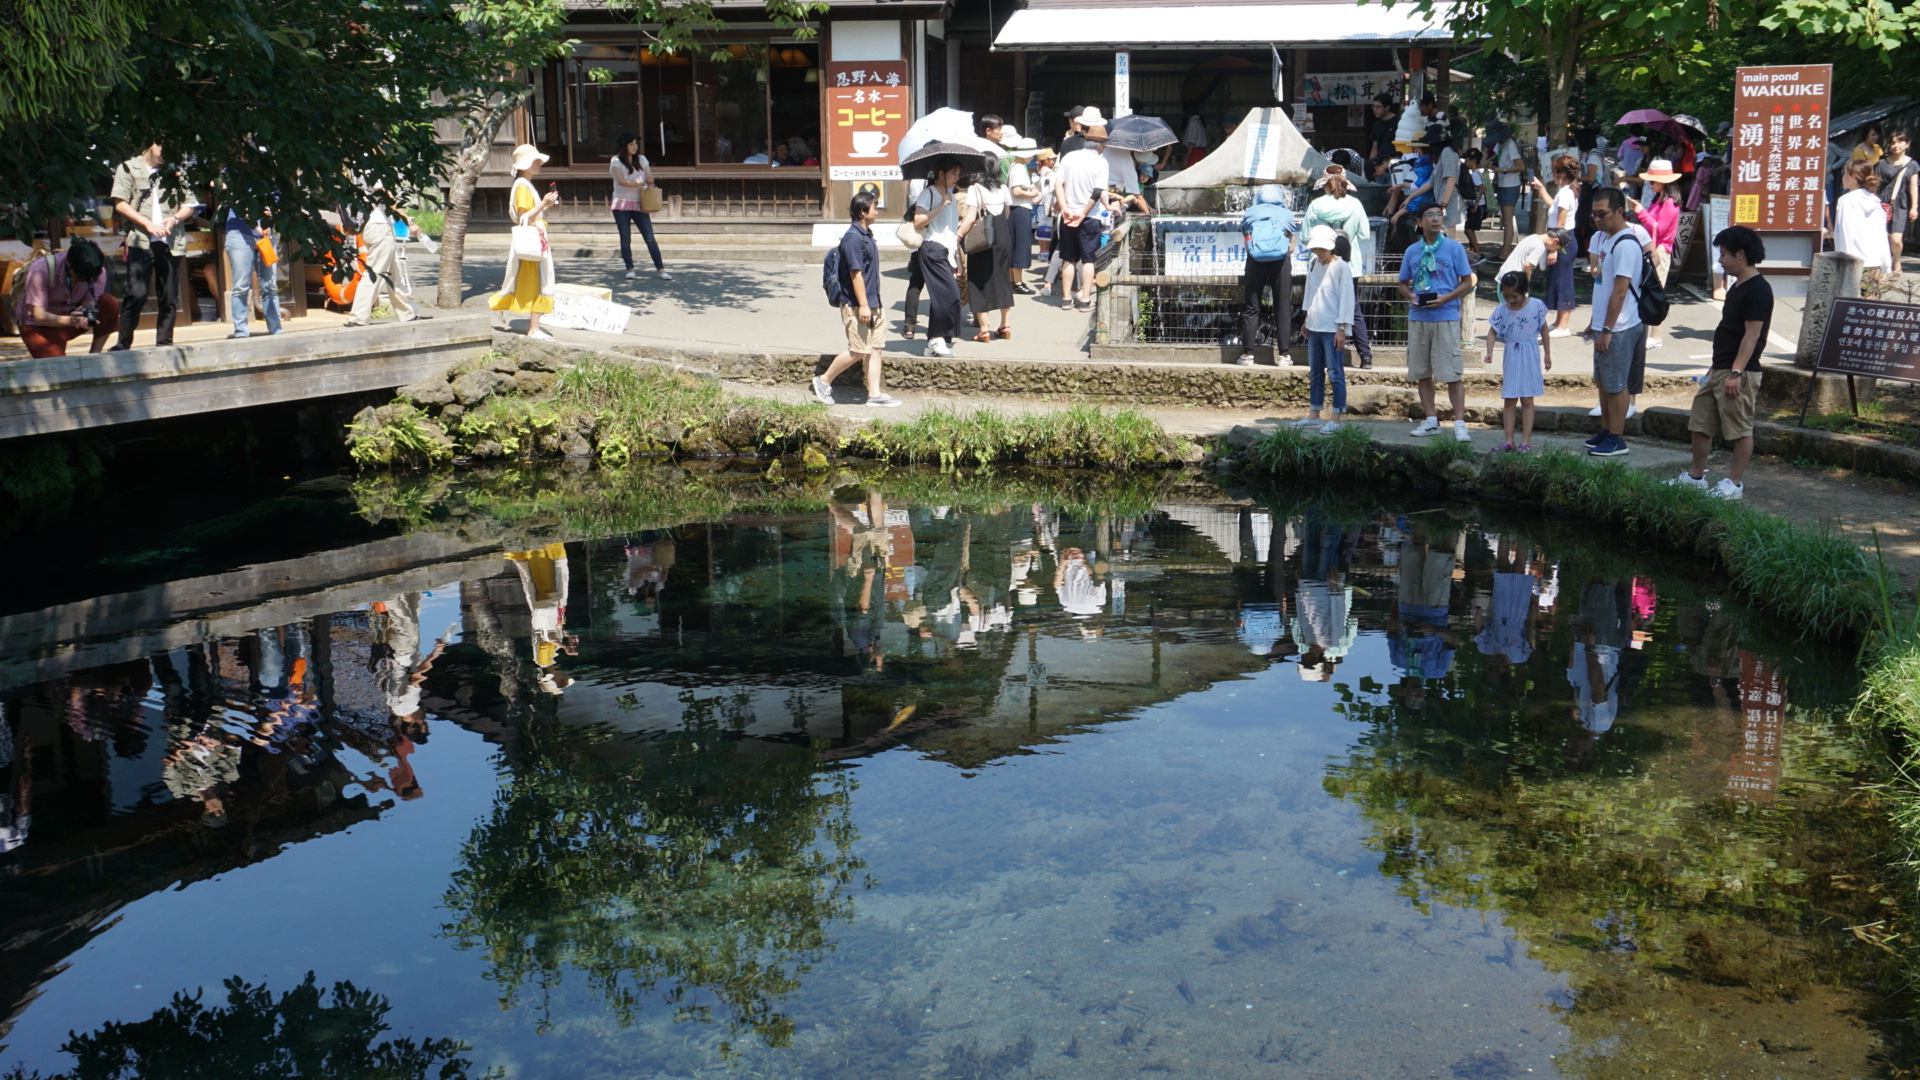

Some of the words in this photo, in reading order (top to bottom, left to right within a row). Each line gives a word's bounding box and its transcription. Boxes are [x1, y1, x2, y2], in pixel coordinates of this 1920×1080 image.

[836, 70, 901, 87] 忍野八海
[1743, 73, 1769, 82] main
[1771, 72, 1799, 83] pond
[853, 89, 882, 104] 名水
[1334, 79, 1400, 101] 松茸茶
[1741, 83, 1825, 97] WAKUIKE
[838, 107, 902, 126] コーヒー
[1738, 123, 1764, 182] 湧池
[1766, 115, 1785, 191] 国指定天然記念物
[1784, 114, 1804, 190] 世界遺産
[1802, 114, 1822, 191] 名水百選
[1173, 235, 1216, 244] 湧き出る
[1182, 244, 1246, 263] 富士山
[582, 315, 621, 332] STOP
[1844, 316, 1859, 324] Please
